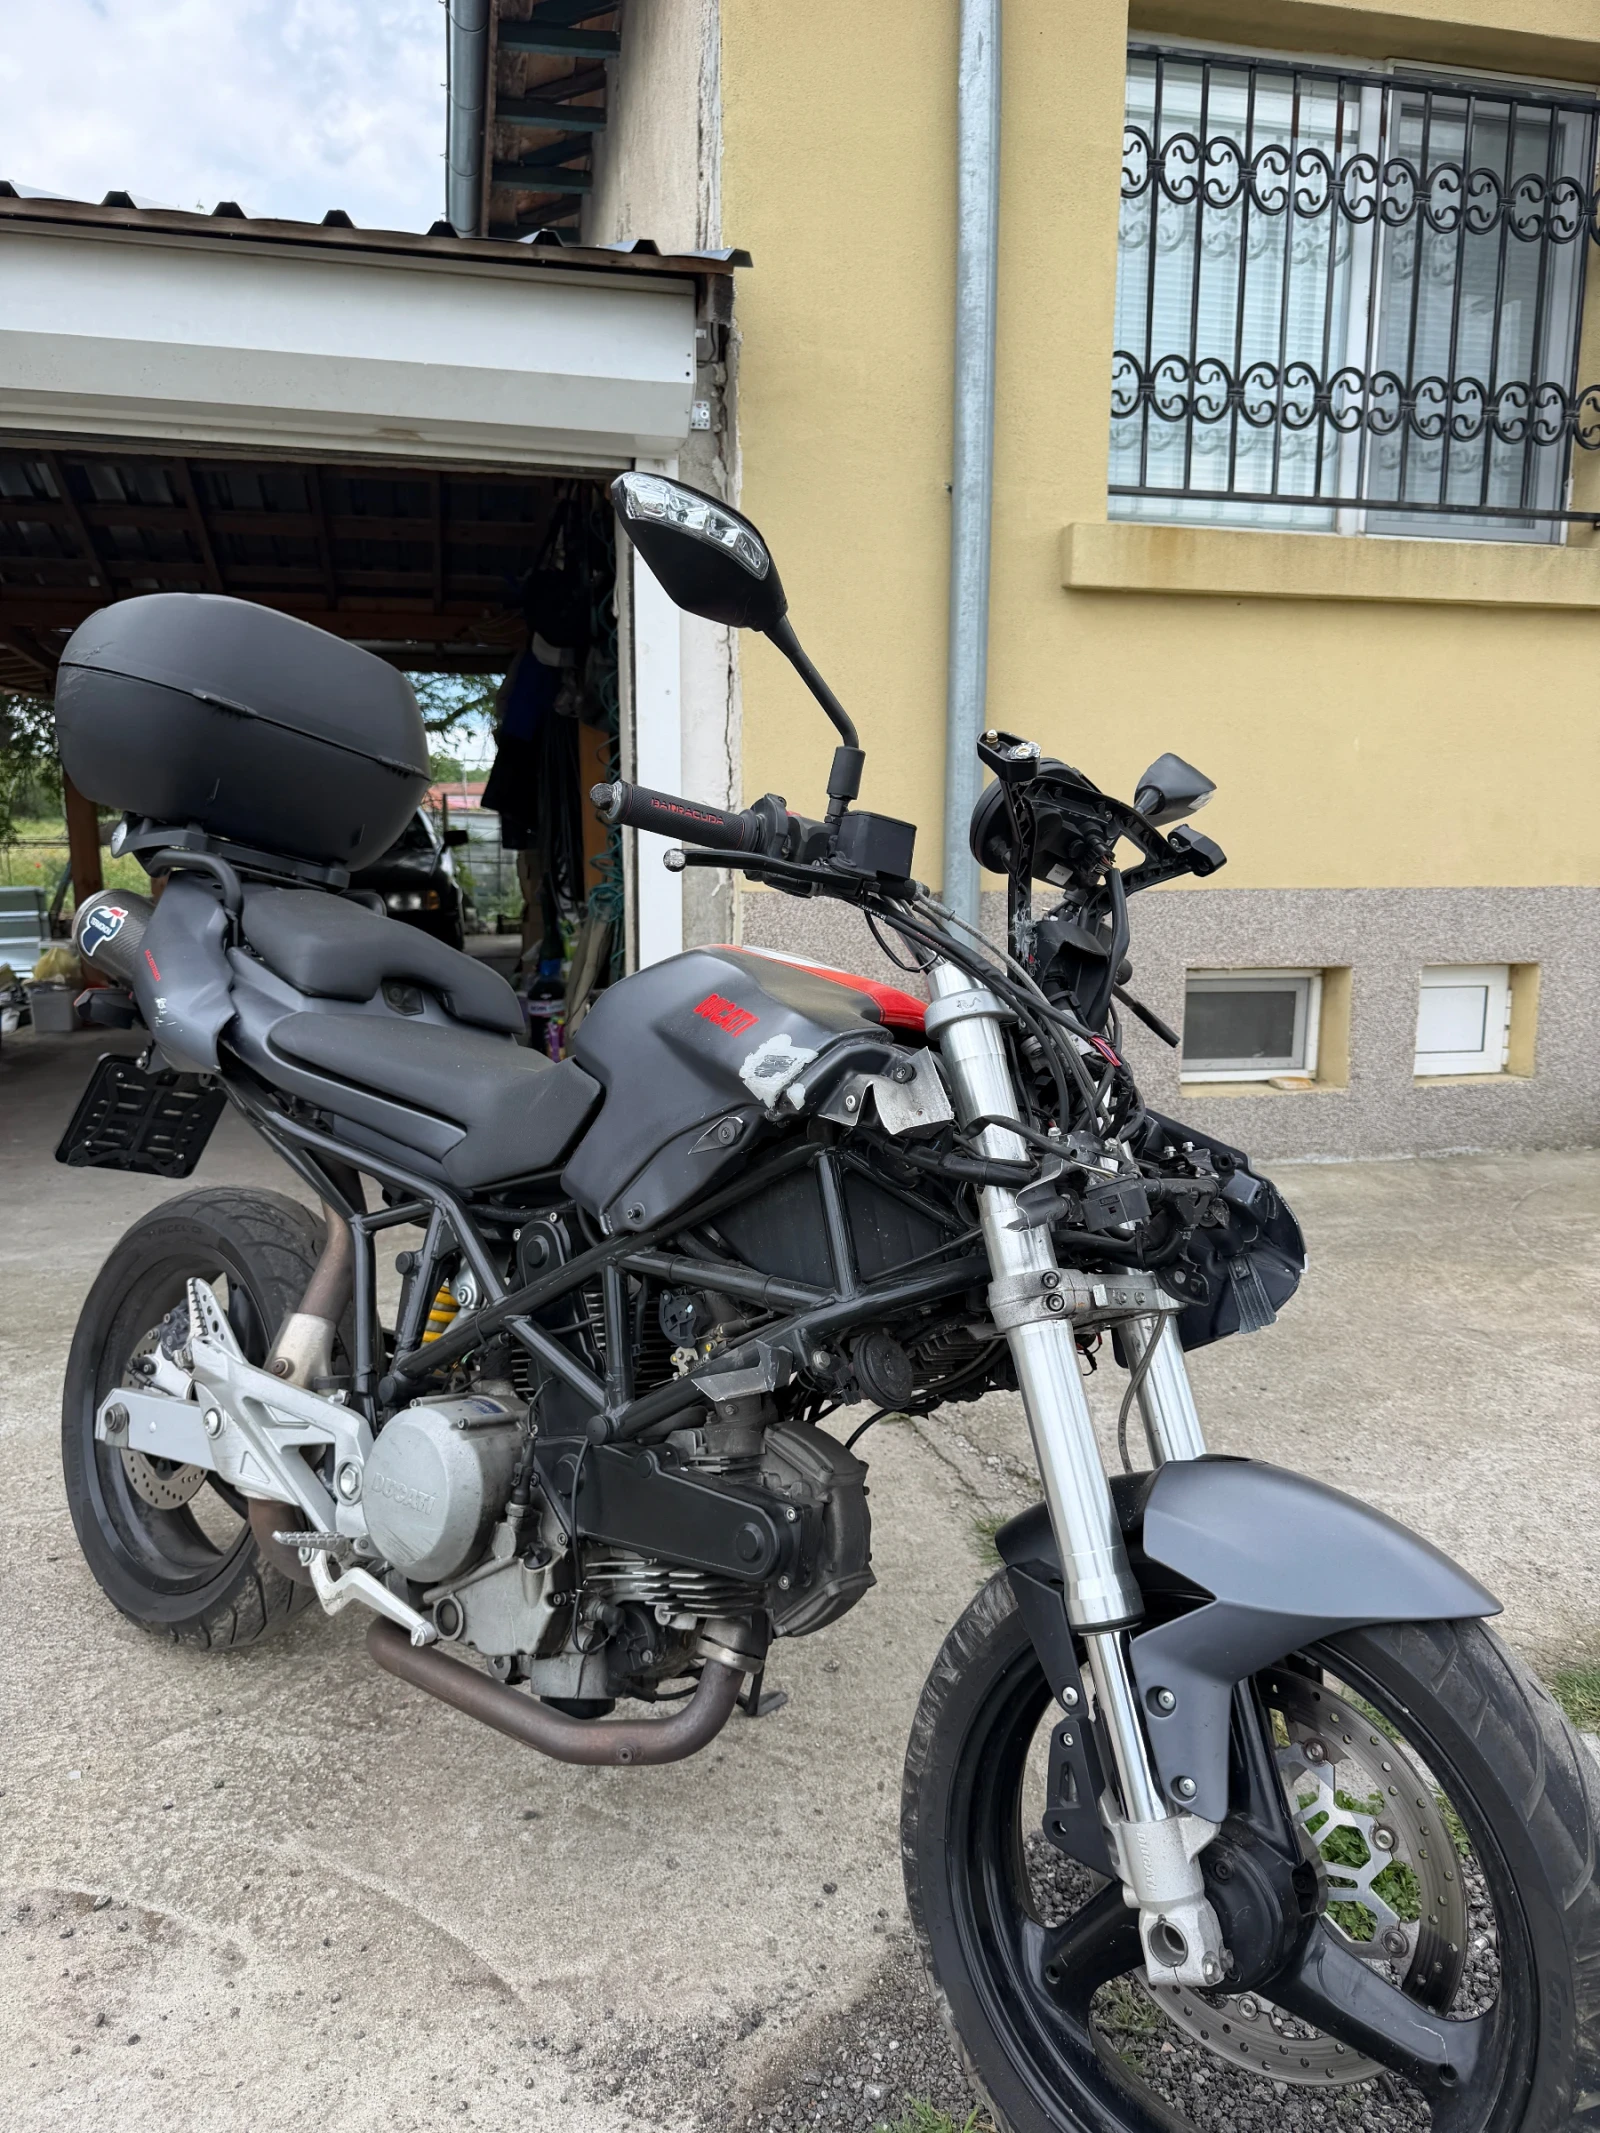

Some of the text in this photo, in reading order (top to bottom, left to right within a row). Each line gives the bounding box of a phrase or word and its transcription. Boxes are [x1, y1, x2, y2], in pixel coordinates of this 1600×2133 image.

[650, 797, 725, 825] BARRACUDA
[693, 993, 760, 1037] DUCATI
[371, 1472, 438, 1516] DUCATI
[1136, 1832, 1157, 1893] DUCATI
